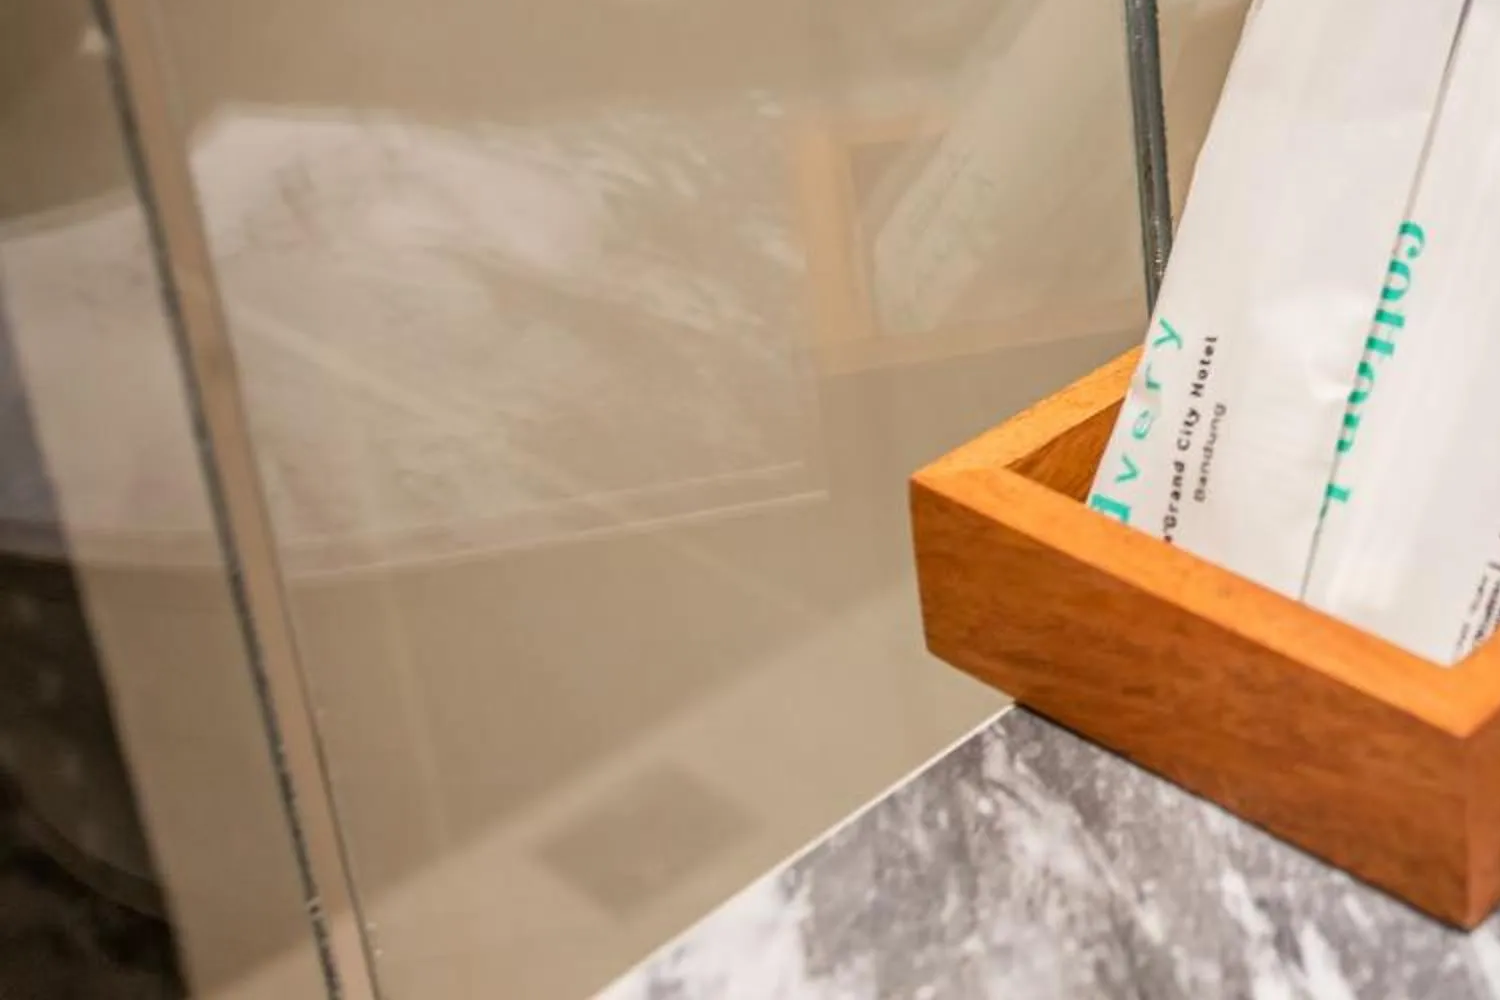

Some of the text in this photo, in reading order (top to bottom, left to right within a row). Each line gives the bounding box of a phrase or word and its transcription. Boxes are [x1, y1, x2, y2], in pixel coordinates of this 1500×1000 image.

[1176, 408, 1198, 451] City
[1190, 335, 1218, 398] Hotel
[1193, 401, 1227, 502] Bandung
